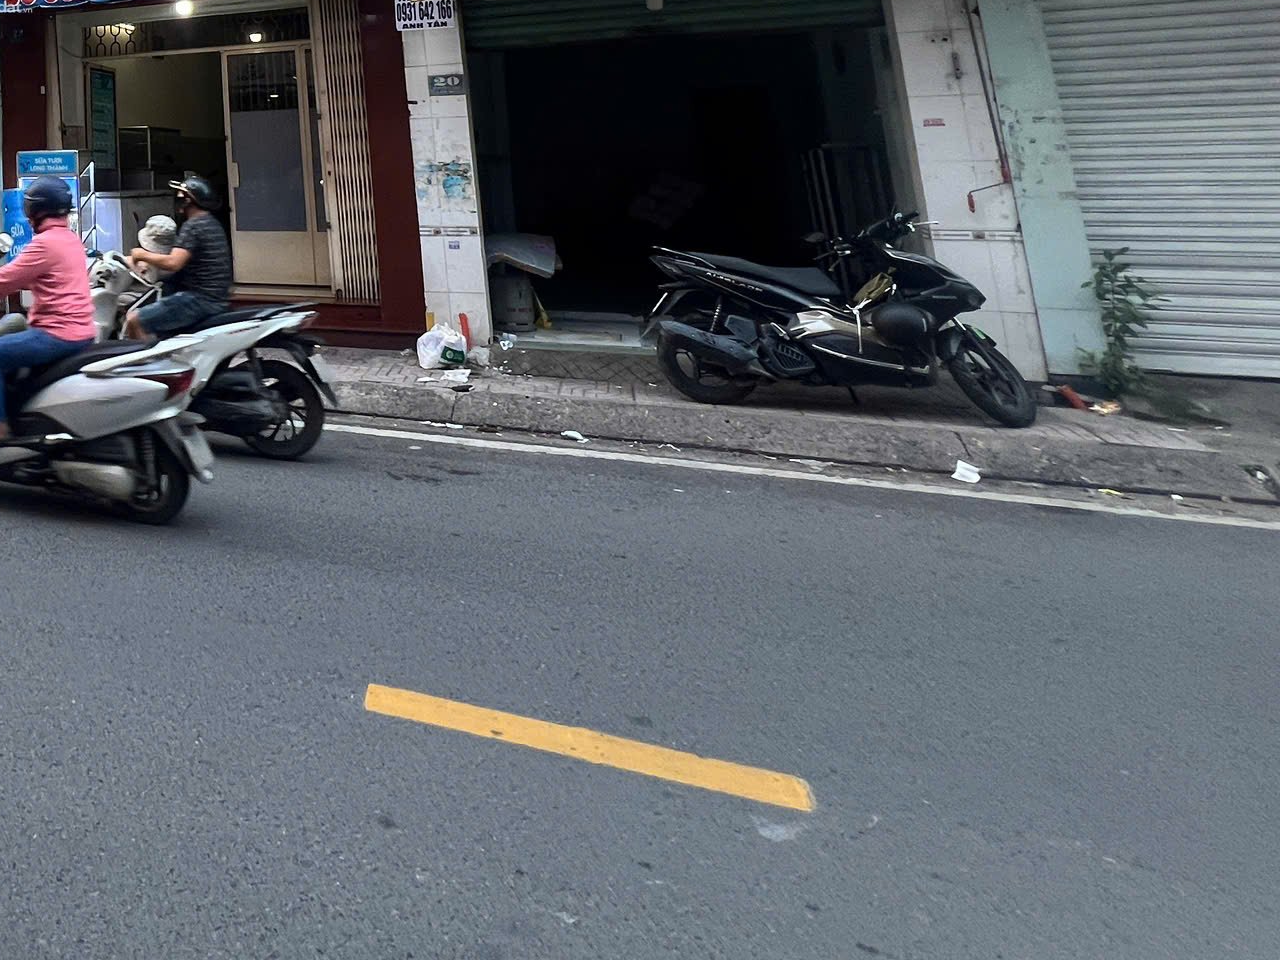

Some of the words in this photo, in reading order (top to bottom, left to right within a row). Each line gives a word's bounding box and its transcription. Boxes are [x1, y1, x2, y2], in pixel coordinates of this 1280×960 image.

[396, 2, 416, 22] 0931
[419, 0, 435, 20] 642
[436, 0, 452, 20] 166
[433, 76, 460, 87] 20
